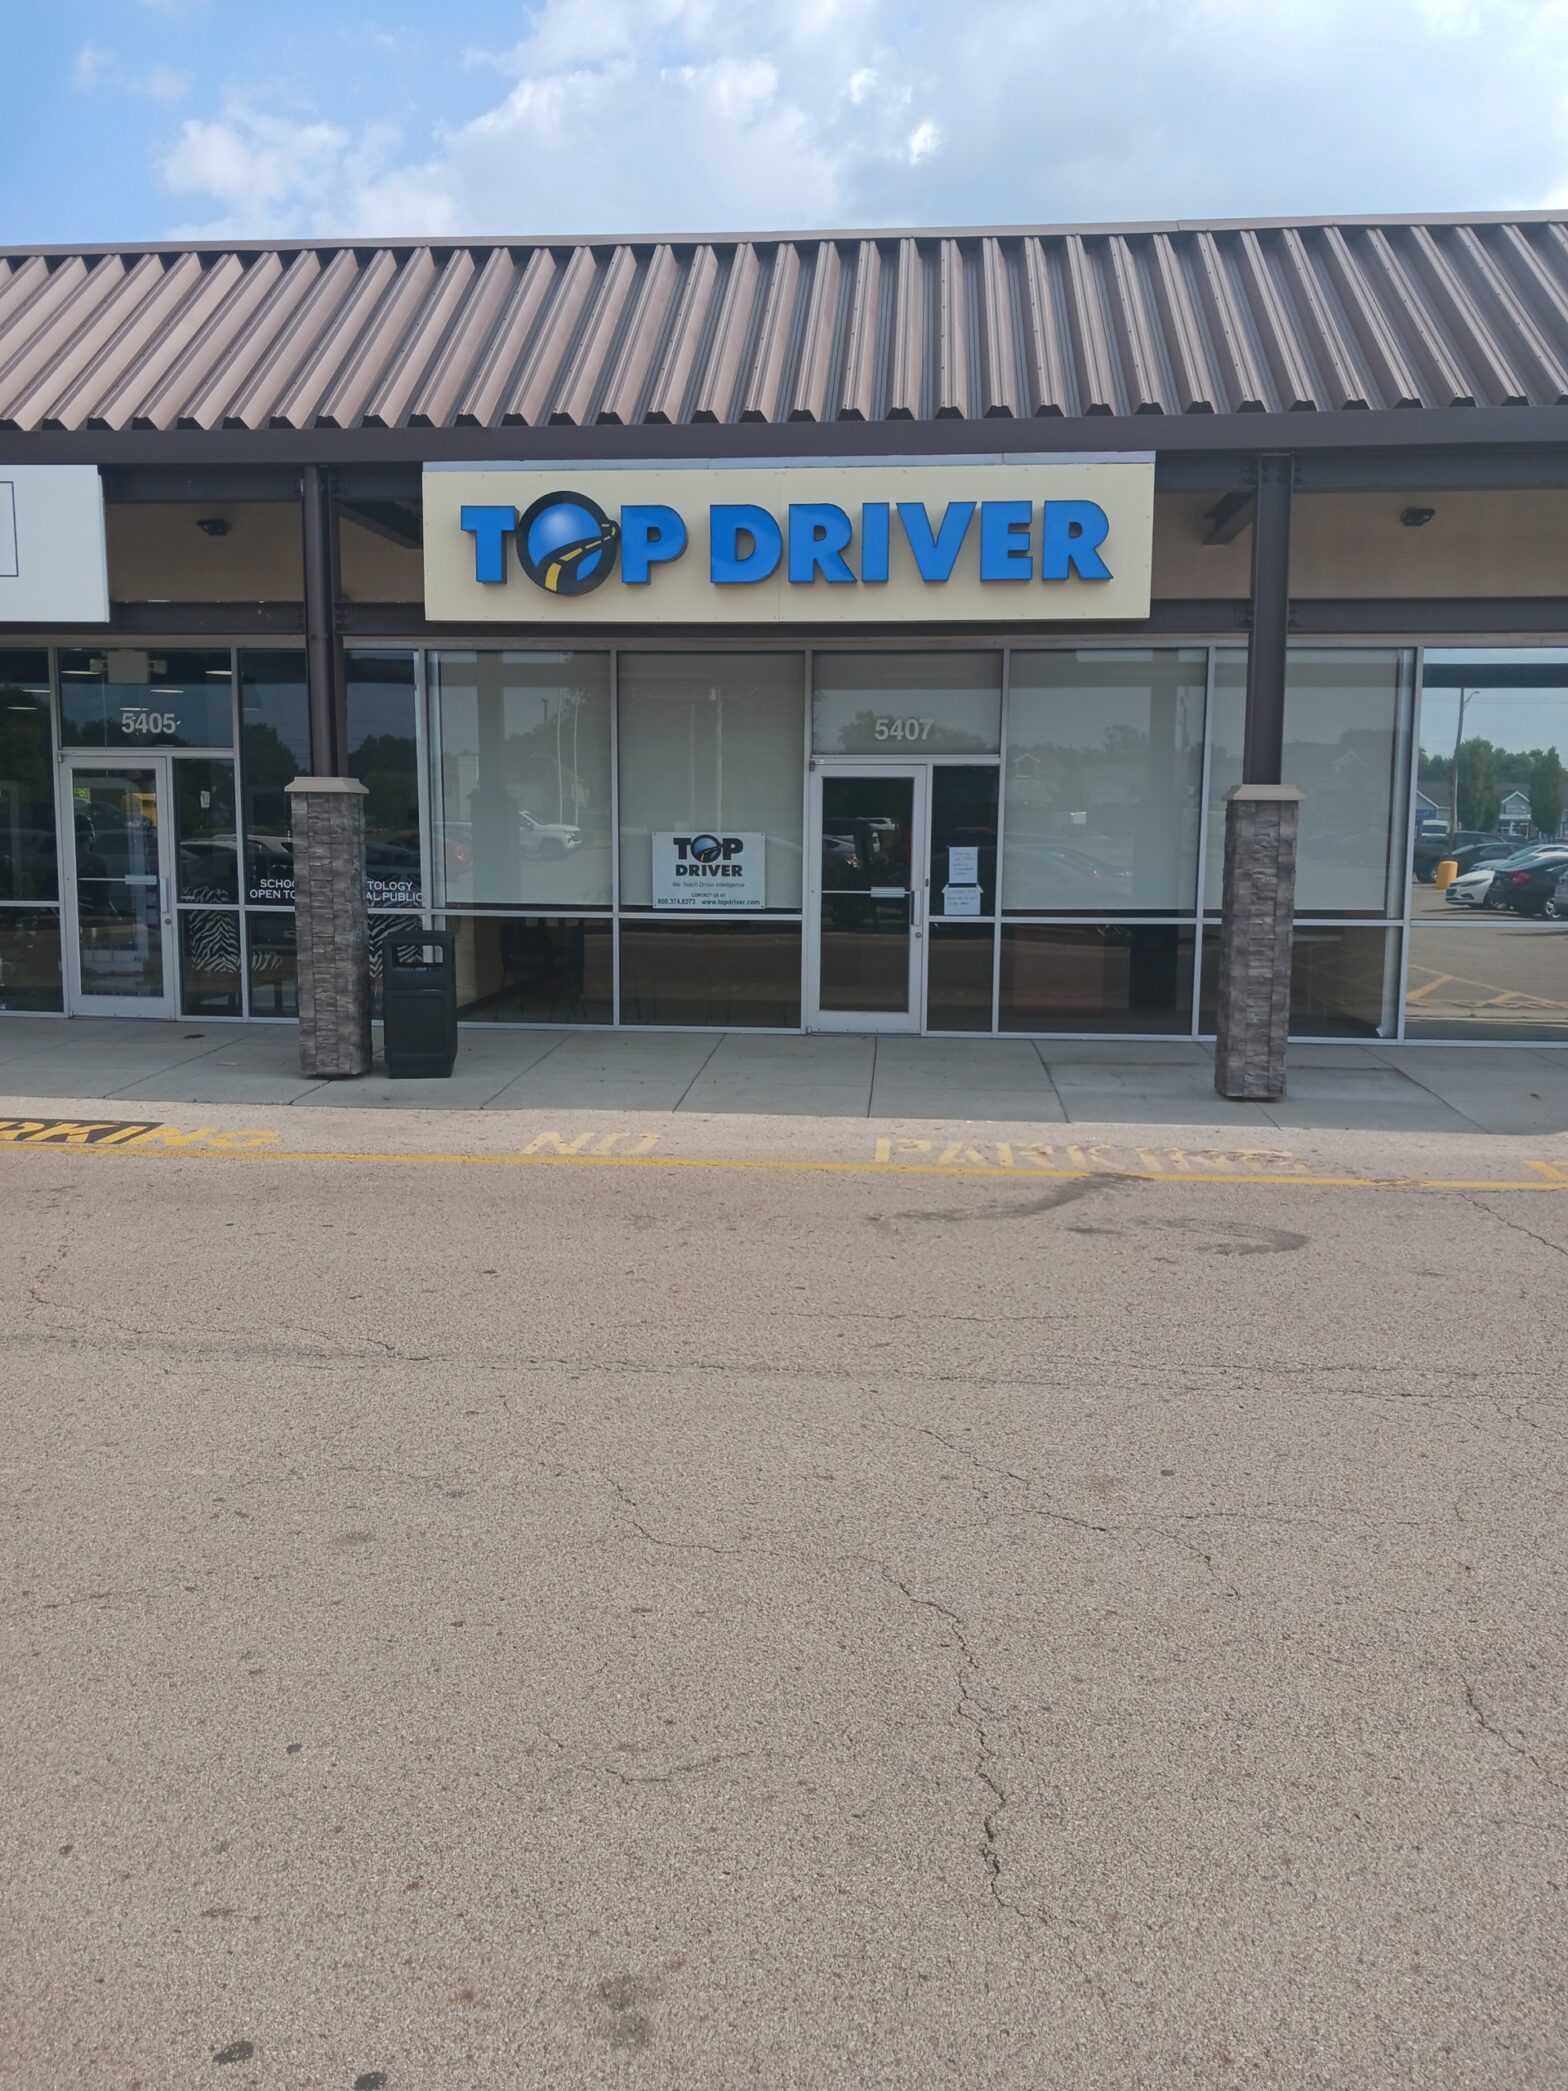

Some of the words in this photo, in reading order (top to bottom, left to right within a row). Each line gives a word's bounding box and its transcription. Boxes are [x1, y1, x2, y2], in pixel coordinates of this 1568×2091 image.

[460, 490, 689, 597] TOP
[709, 500, 1114, 584] DRIVER
[121, 712, 177, 734] 5405
[874, 718, 934, 740] 5407
[673, 834, 744, 863] TOP
[675, 864, 743, 877] DRIVER
[249, 888, 281, 899] OPEN
[366, 891, 381, 902] AL
[382, 892, 424, 902] PUBLIC
[367, 880, 413, 891] TOLOGY
[701, 898, 761, 907] www.topdriver.com
[0, 1121, 280, 1147] RKING
